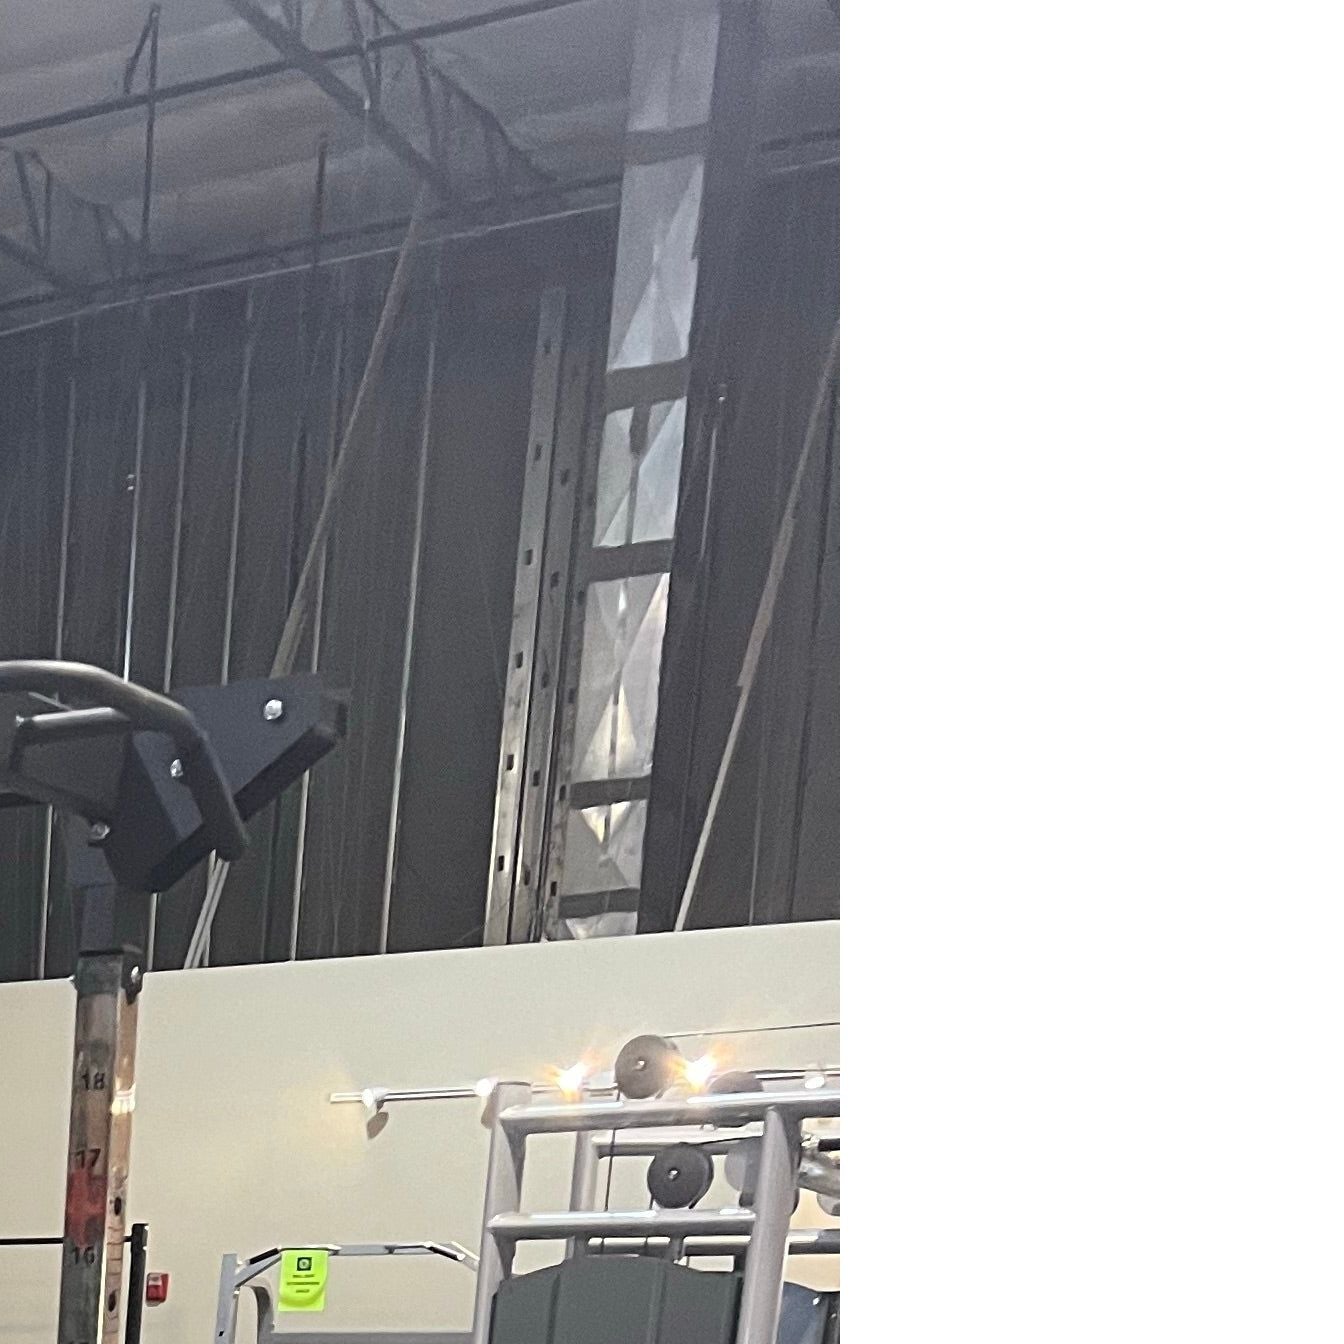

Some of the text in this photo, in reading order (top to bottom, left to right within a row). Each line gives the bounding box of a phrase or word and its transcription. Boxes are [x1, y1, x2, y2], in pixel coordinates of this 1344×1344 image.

[81, 1071, 106, 1091] 18
[75, 1148, 101, 1169] 17
[72, 1246, 96, 1265] 16
